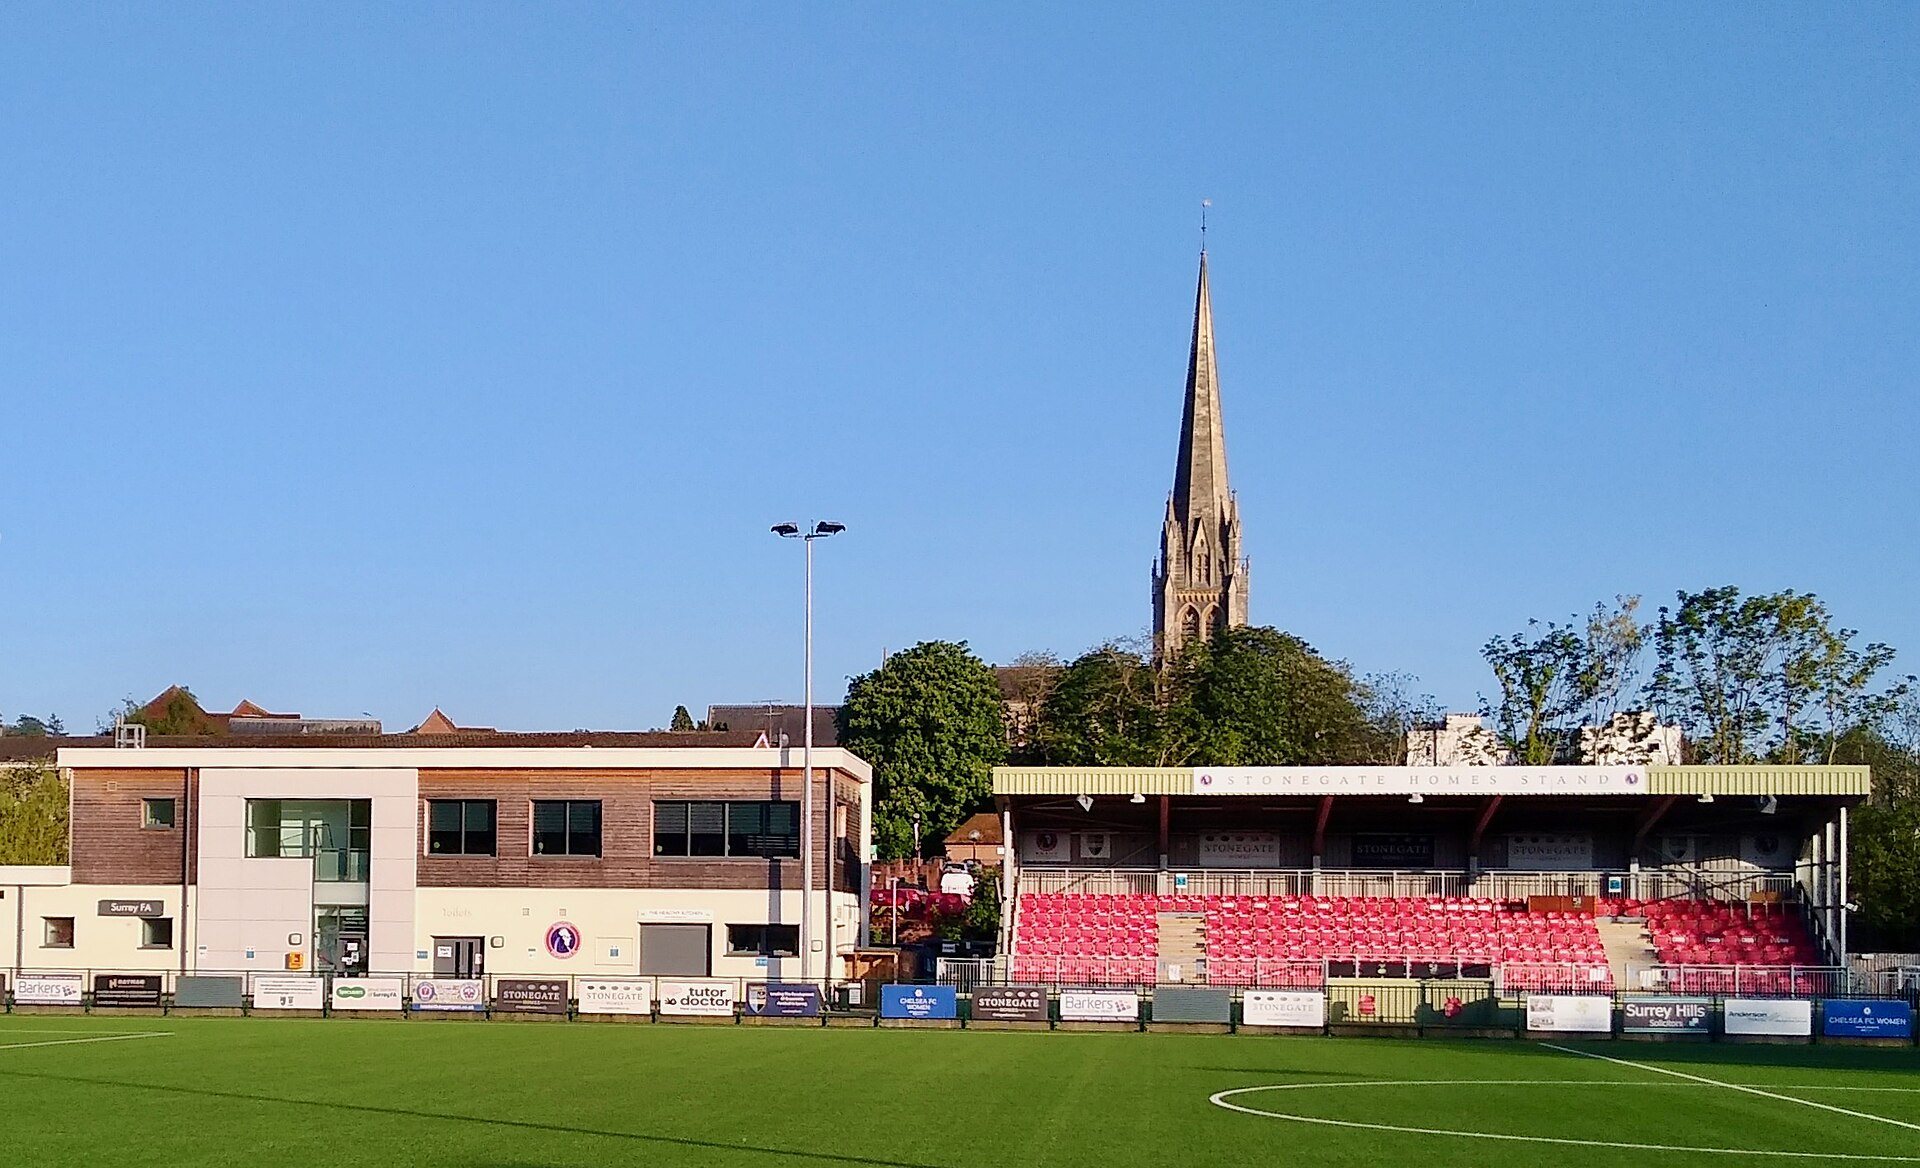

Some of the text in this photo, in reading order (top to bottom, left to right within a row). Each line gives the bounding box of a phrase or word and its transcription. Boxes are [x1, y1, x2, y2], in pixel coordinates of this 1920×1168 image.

[1227, 775, 1609, 785] STONEGATE HOMES STAND
[1204, 844, 1274, 853] STONEGATE
[110, 902, 152, 914] Surrey FA
[18, 981, 61, 994] Barkers
[689, 987, 727, 997] tutor
[503, 990, 560, 1001] STONEGATE
[586, 992, 643, 1001] STONEGATE
[680, 995, 732, 1006] doctor
[899, 997, 928, 1005] CHELSEA
[978, 998, 1040, 1008] STONEGATE
[1065, 996, 1113, 1009] Barkers
[1253, 1003, 1314, 1012] STONEGATE
[1626, 1003, 1706, 1019] Surrey Hills
[1649, 1018, 1683, 1027] Solicitors
[1828, 1016, 1863, 1024] CHELSEA
[1876, 1017, 1907, 1025] WOMEN
